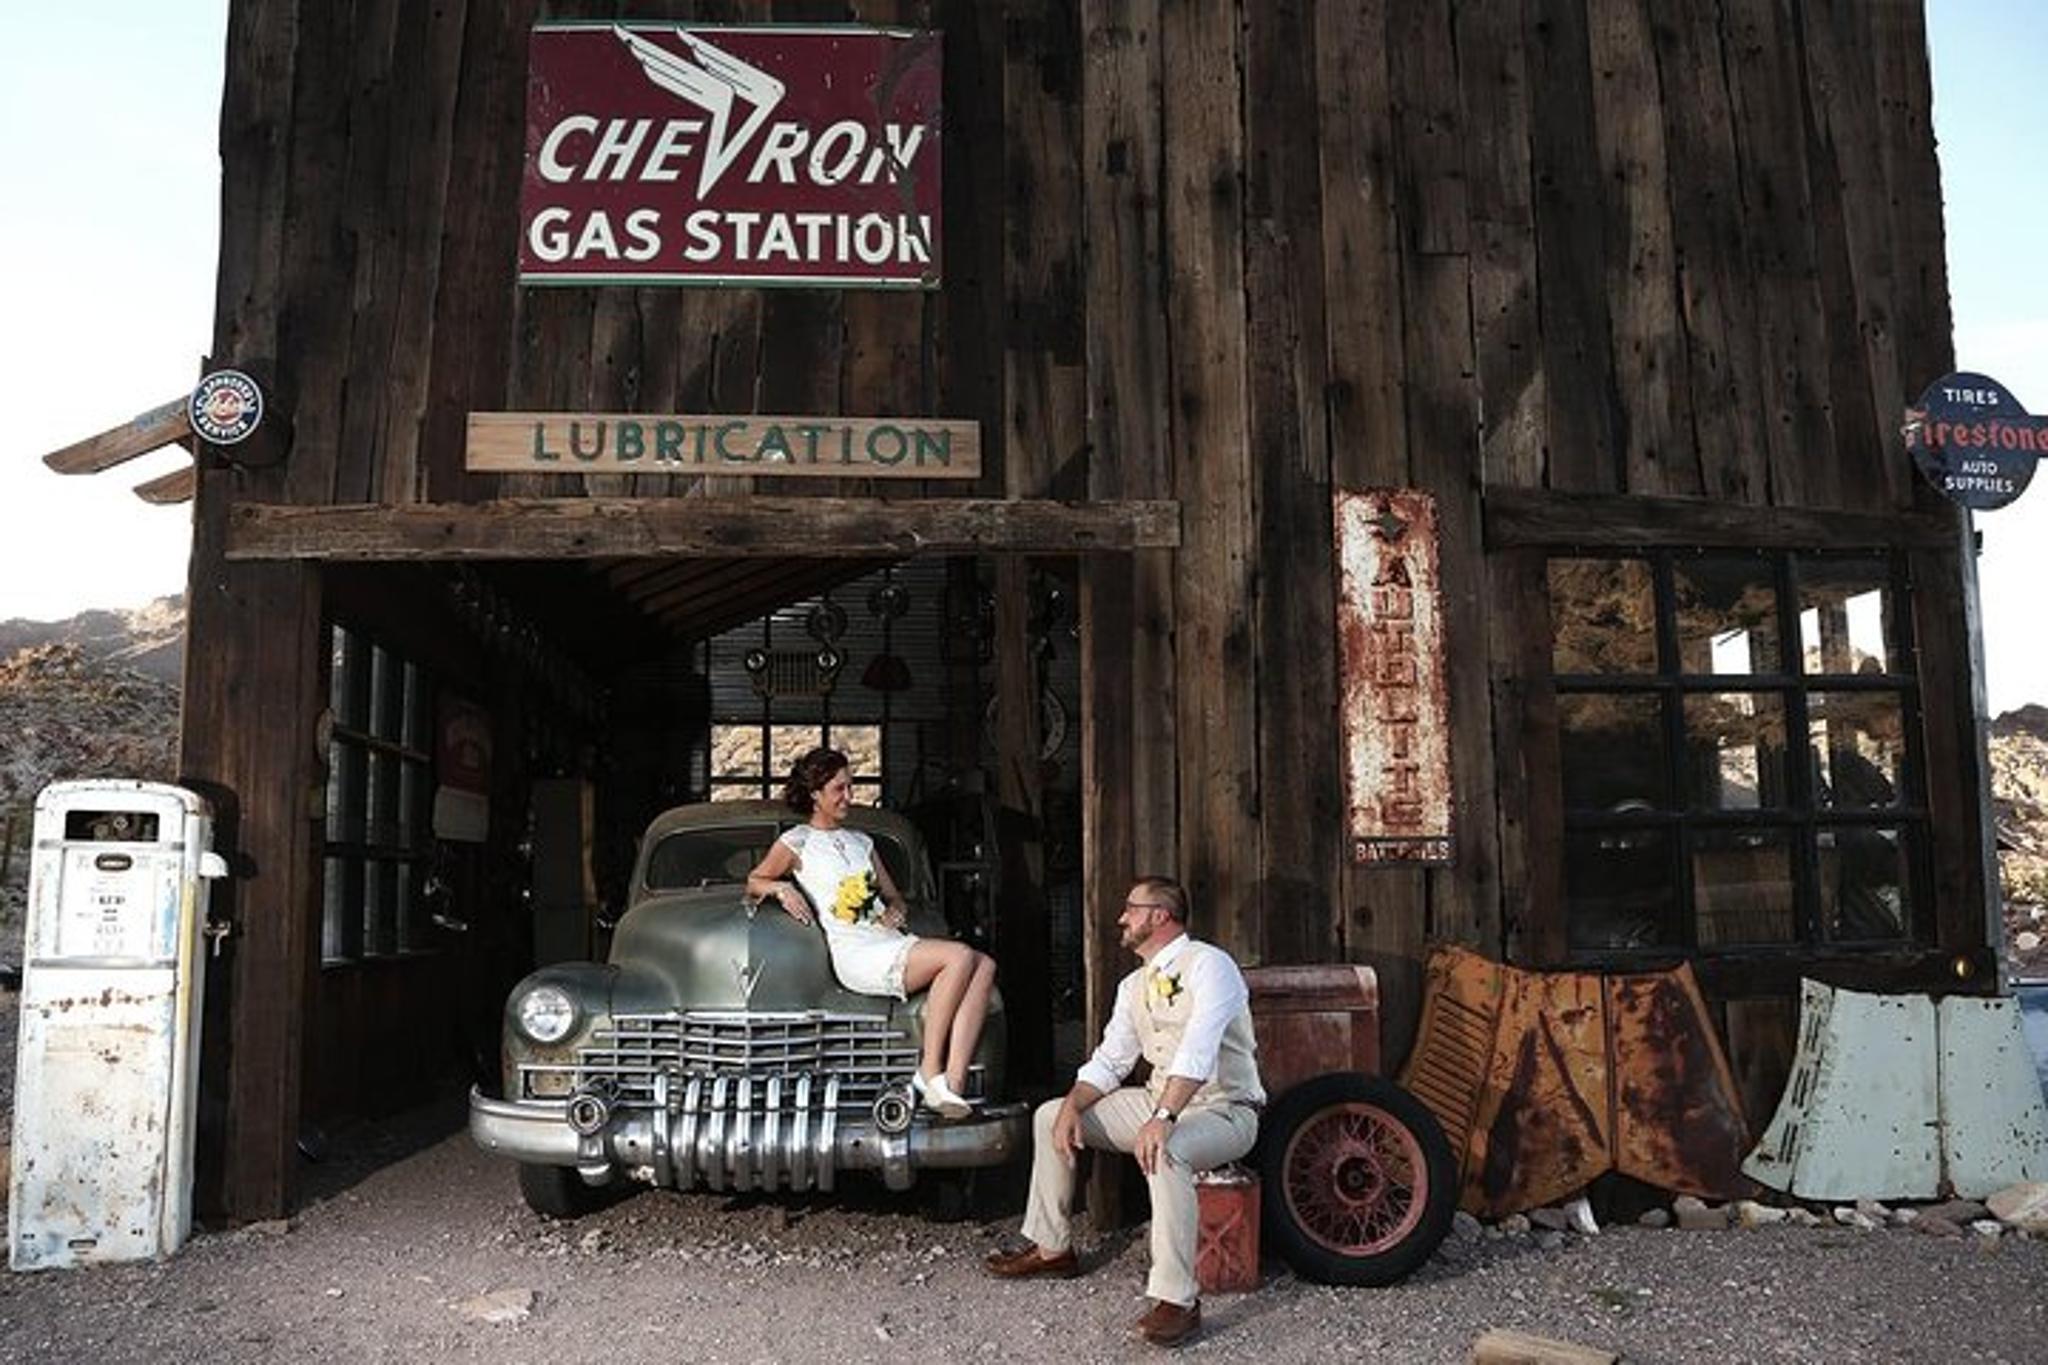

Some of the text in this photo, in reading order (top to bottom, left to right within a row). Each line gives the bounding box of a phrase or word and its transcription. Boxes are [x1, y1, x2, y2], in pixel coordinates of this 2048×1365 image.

[536, 88, 926, 200] CHEVRON
[529, 208, 931, 264] GAS STATION
[1943, 388, 1998, 405] TIRES
[533, 420, 952, 467] LUBRICATION
[1962, 460, 1998, 475] AUTO
[1944, 476, 2014, 493] SUPPLIES
